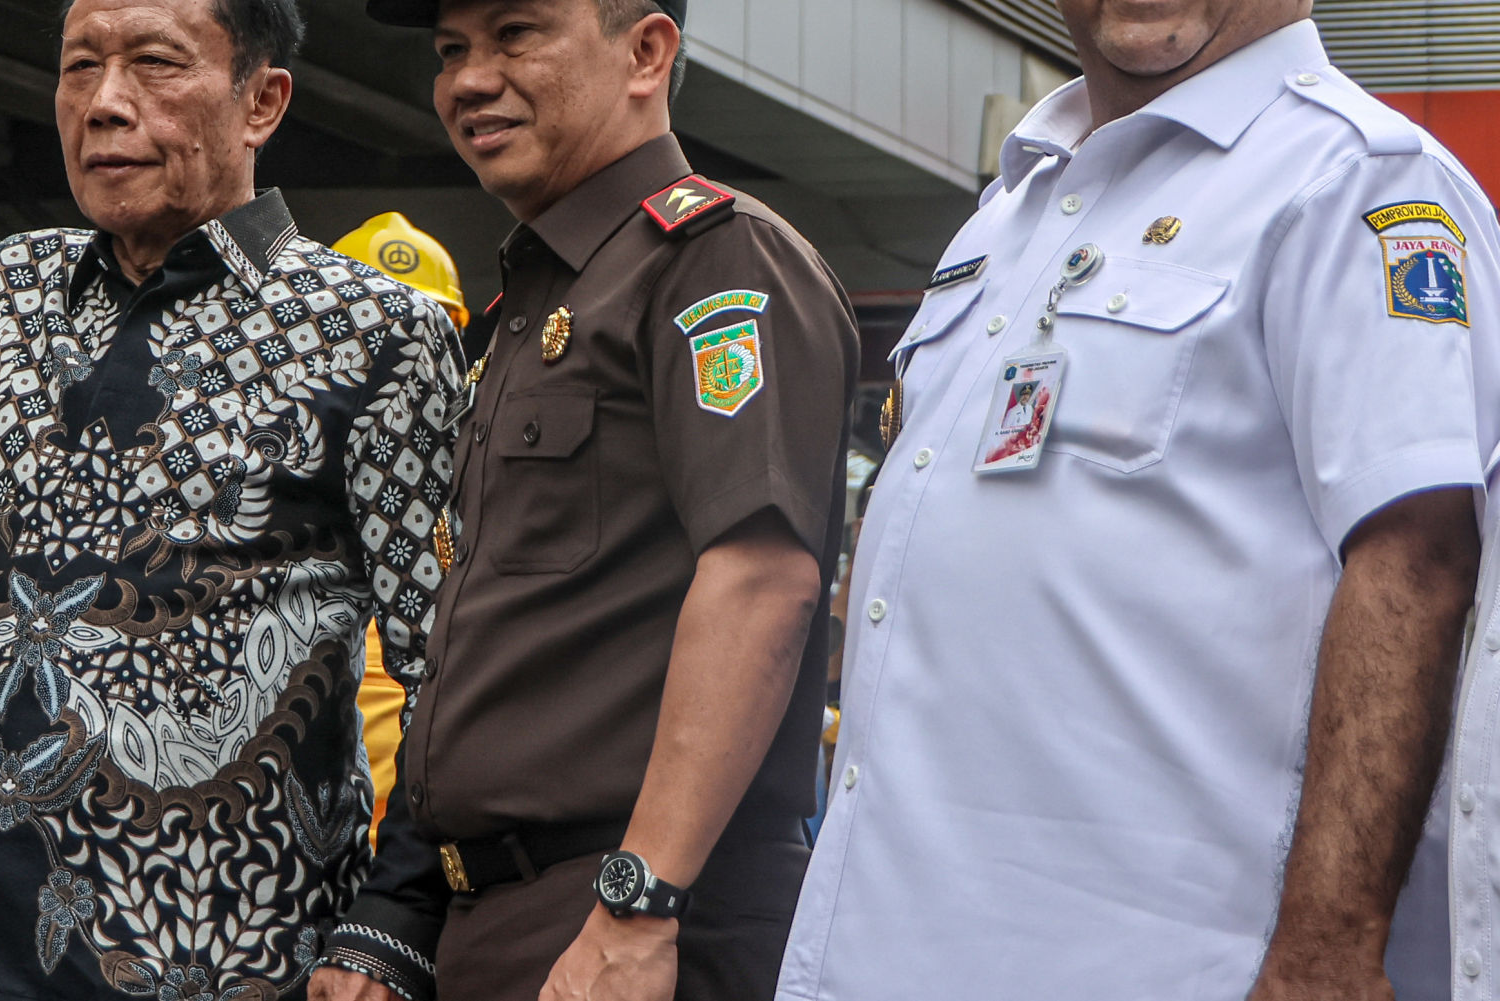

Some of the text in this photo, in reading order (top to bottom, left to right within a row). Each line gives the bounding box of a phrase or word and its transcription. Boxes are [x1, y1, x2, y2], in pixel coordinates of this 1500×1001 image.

[1371, 205, 1414, 227] PEMPROV
[1415, 204, 1432, 217] DKI
[1392, 240, 1458, 257] JAYA RAYA
[682, 294, 762, 327] KEJAKSAAN RI
